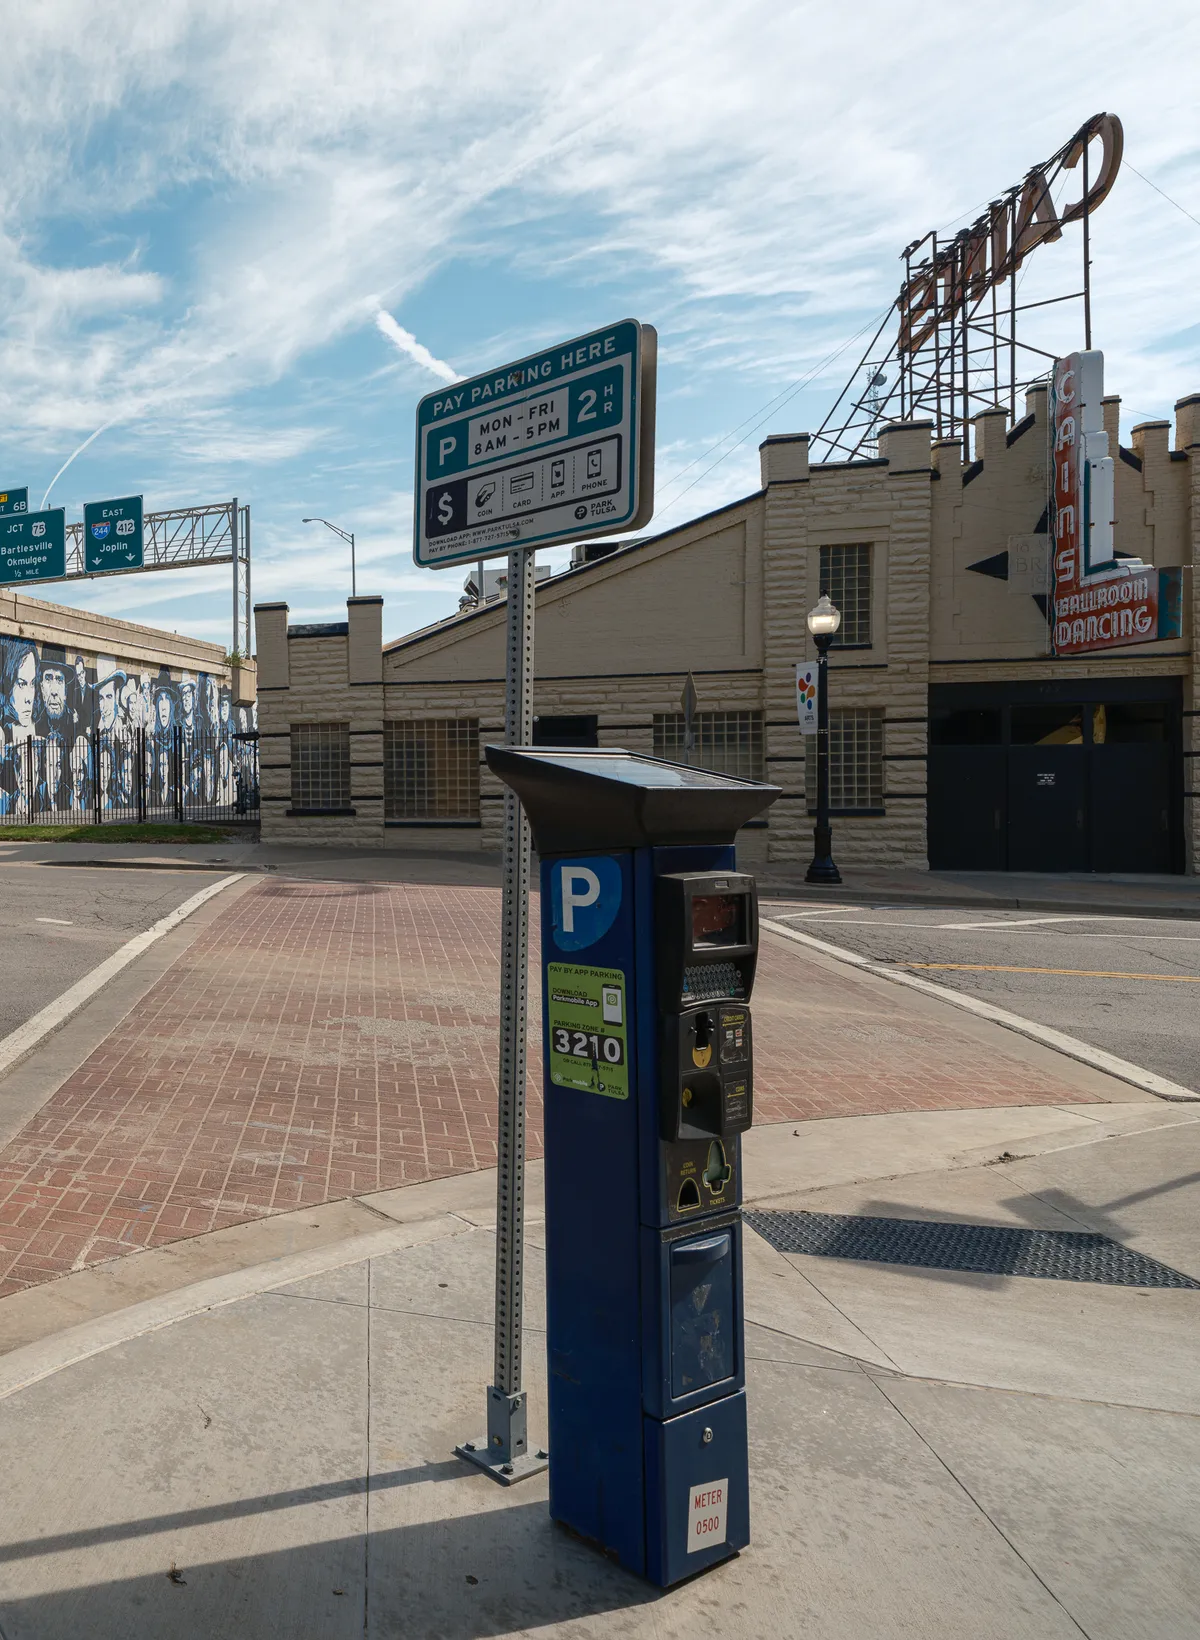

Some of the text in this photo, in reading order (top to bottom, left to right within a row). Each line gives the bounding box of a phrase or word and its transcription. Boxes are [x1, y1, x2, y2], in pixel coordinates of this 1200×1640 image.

[433, 336, 616, 416] PAY PARKING HERE
[577, 389, 598, 423] 2
[480, 414, 512, 435] MON
[529, 401, 554, 420] FRI
[438, 436, 457, 466] P
[581, 479, 608, 491] PHONE
[550, 490, 565, 499] APP
[13, 502, 26, 511] 6B
[512, 498, 531, 509] CARD
[590, 499, 612, 509] PARK
[102, 508, 124, 518] EAST
[477, 508, 493, 517] COIN
[590, 505, 617, 516] TULSA
[6, 523, 45, 534] JCT 75
[94, 522, 134, 536] 244 412
[428, 518, 534, 547] DOWNLOAD APP: WWW.PARKTULSA.COM
[0, 542, 53, 555] Bartlesville
[99, 541, 128, 553] Joplin
[6, 555, 47, 567] Okmulgee
[25, 568, 40, 576] MILE
[1056, 577, 1148, 618] BALLROOM
[1055, 606, 1152, 647] DANCING
[561, 866, 601, 932] P
[550, 965, 563, 973] PAY
[574, 968, 589, 976] APP
[590, 971, 623, 980] PARKING
[552, 987, 588, 997] DOWNLOAD
[585, 1000, 599, 1008] App
[553, 1020, 581, 1029] PARKING
[555, 1029, 620, 1063] 3210
[607, 1089, 626, 1097] TULSA
[694, 1489, 722, 1509] METER
[696, 1516, 719, 1535] 0500
